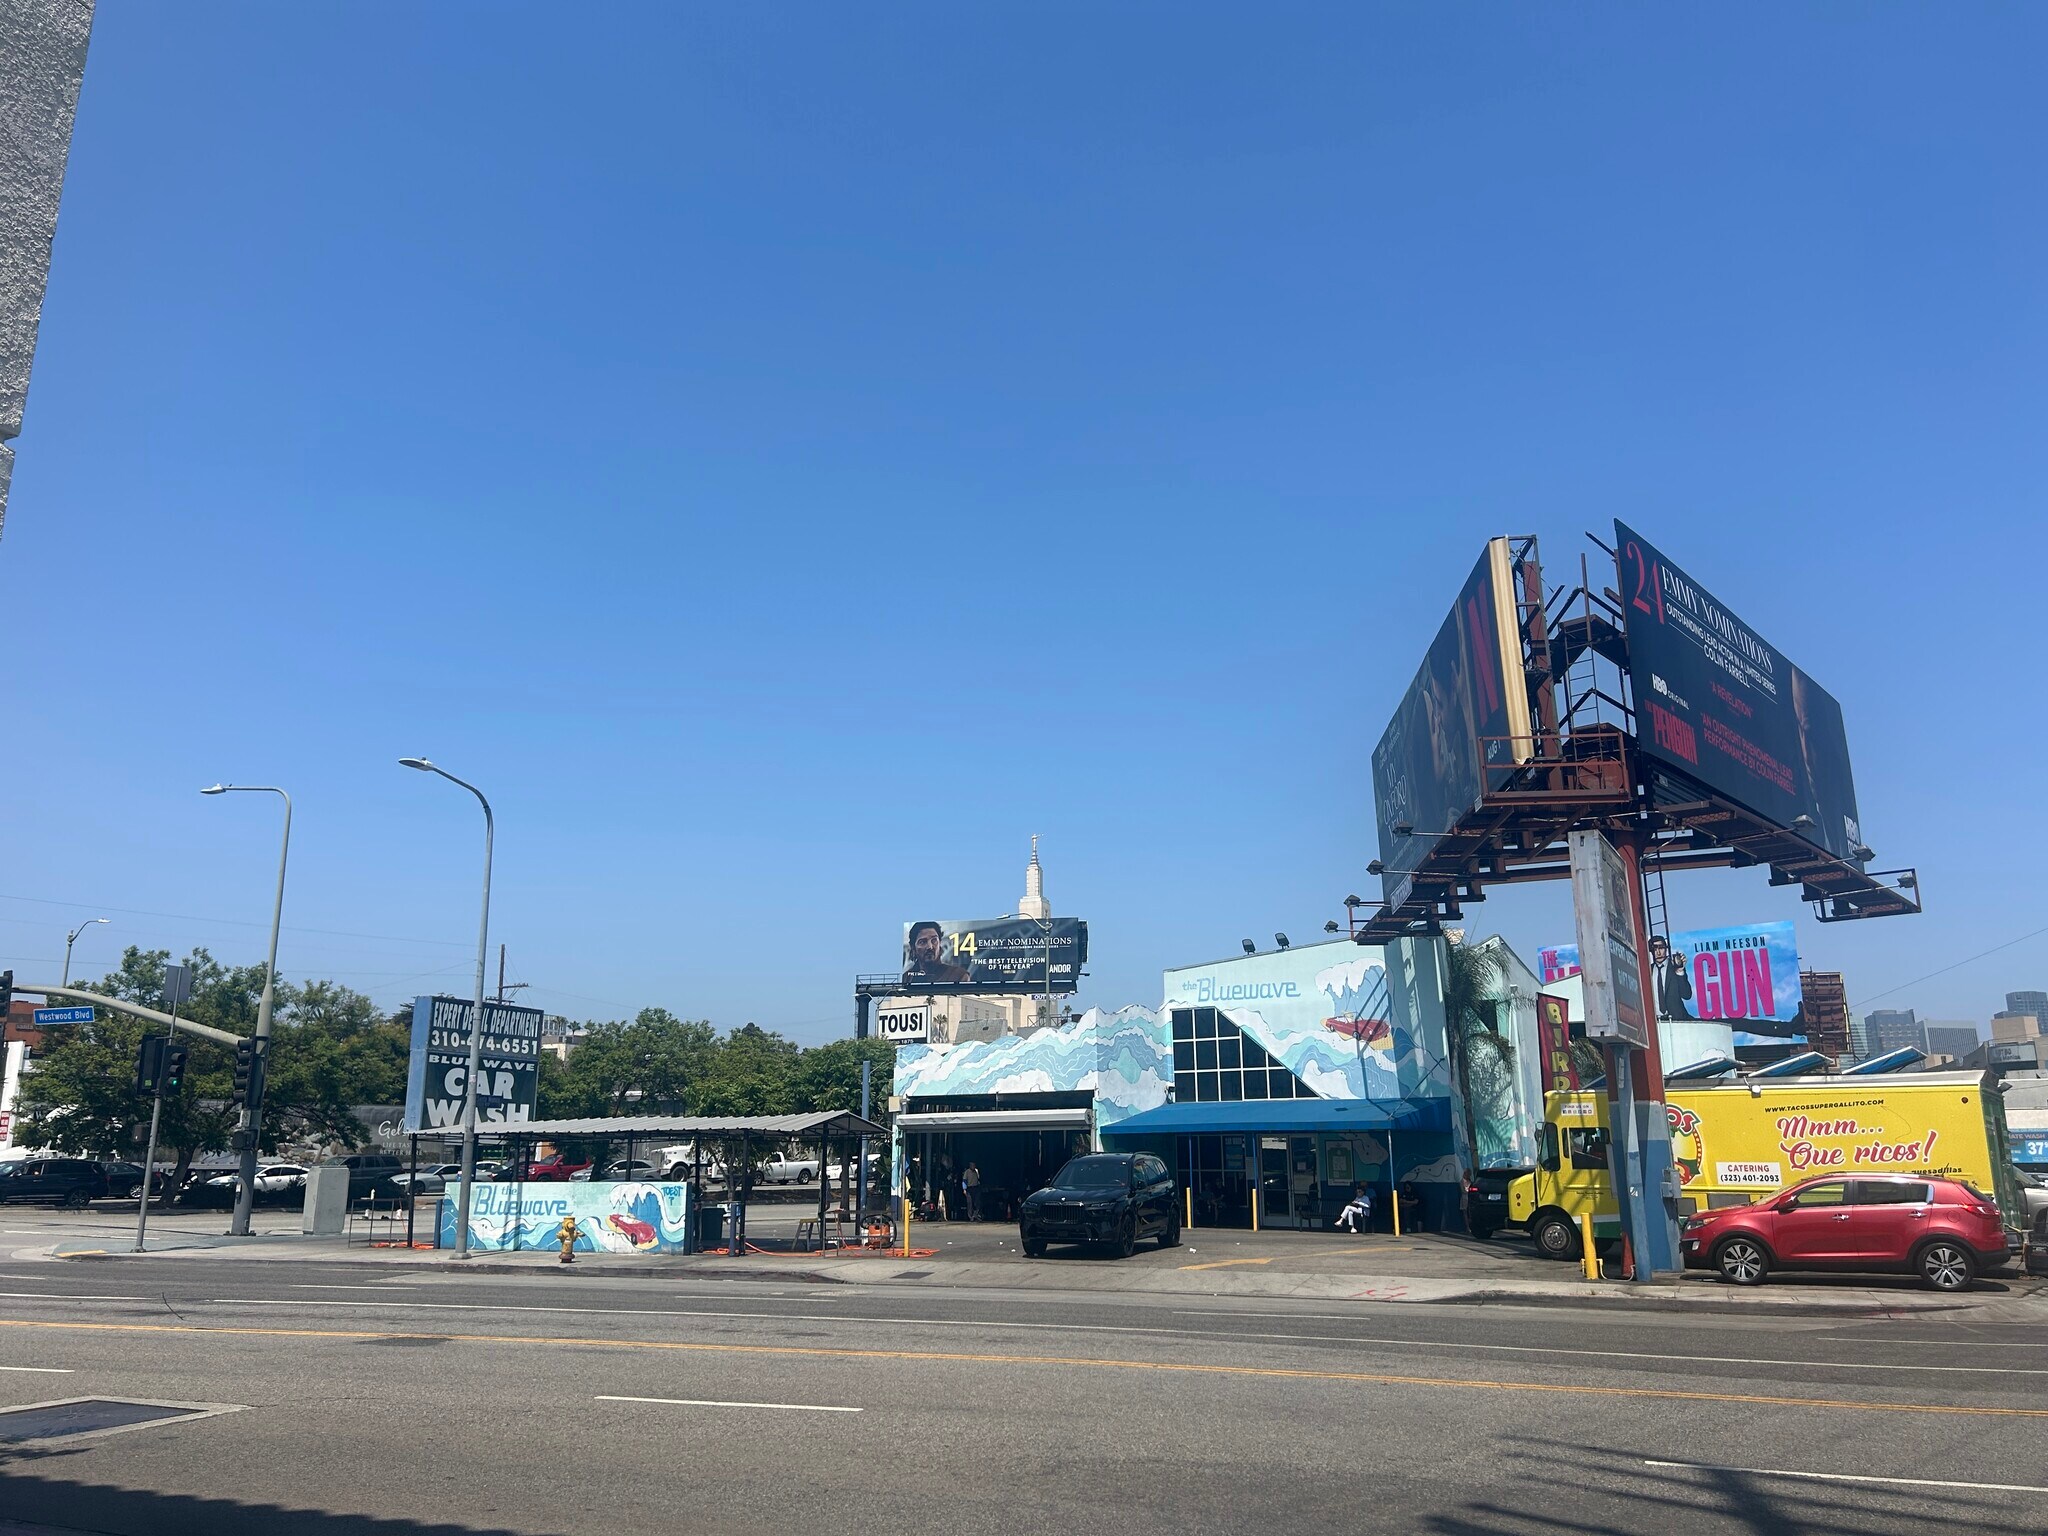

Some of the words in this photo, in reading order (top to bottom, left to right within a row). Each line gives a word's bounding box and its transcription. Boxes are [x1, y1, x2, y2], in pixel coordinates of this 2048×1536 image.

[1627, 541, 1665, 625] 24
[1661, 565, 1699, 615] EMMY
[1701, 597, 1773, 674] NOMINATIONS
[1666, 602, 1704, 639] OUTSTANDING
[1704, 630, 1718, 649] LEAD
[1718, 642, 1734, 663] ACTOR
[1744, 662, 1762, 683] LIMITED
[1761, 676, 1776, 695] SERIES
[1704, 644, 1724, 668] COLIN
[1724, 659, 1750, 688] FARRELL
[1652, 673, 1668, 696] HBO
[1667, 690, 1689, 710] ORIGINAL
[1653, 703, 1698, 766] PENGUIN
[1704, 728, 1748, 766] PERFORMANCE
[1487, 741, 1498, 762] AUG
[1383, 774, 1406, 825] OXFORD
[948, 932, 978, 957] 14
[978, 938, 1005, 947] EMMY
[1694, 939, 1720, 953] LIAM
[1725, 935, 1767, 950] NEESON
[1049, 964, 1072, 974] ANDOR
[1541, 950, 1559, 969] THE
[1182, 981, 1198, 991] the
[1197, 977, 1301, 1002] Bluewave
[1693, 948, 1776, 1020] GUN
[39, 1012, 72, 1021] Westwood
[75, 1011, 90, 1019] Blvd
[433, 1001, 463, 1029] EXPERT
[462, 1005, 490, 1032] DEIL
[490, 1009, 540, 1038] DEPARTMENT
[879, 1012, 922, 1033] TOUSI
[483, 1059, 535, 1071] WAVE
[444, 1067, 515, 1100] CAR
[426, 1098, 530, 1128] WASH
[1764, 1099, 1884, 1113] WWW.TACOSSUPERGALLITO.COM
[1779, 1141, 1845, 1170] Que
[1854, 1130, 1938, 1164] ricos!
[1720, 1174, 1741, 1182] (323)
[1742, 1174, 1780, 1182] 401-2093
[1727, 1164, 1770, 1173] CATERING
[473, 1185, 573, 1215] Bluewave
[501, 1185, 518, 1196] the
